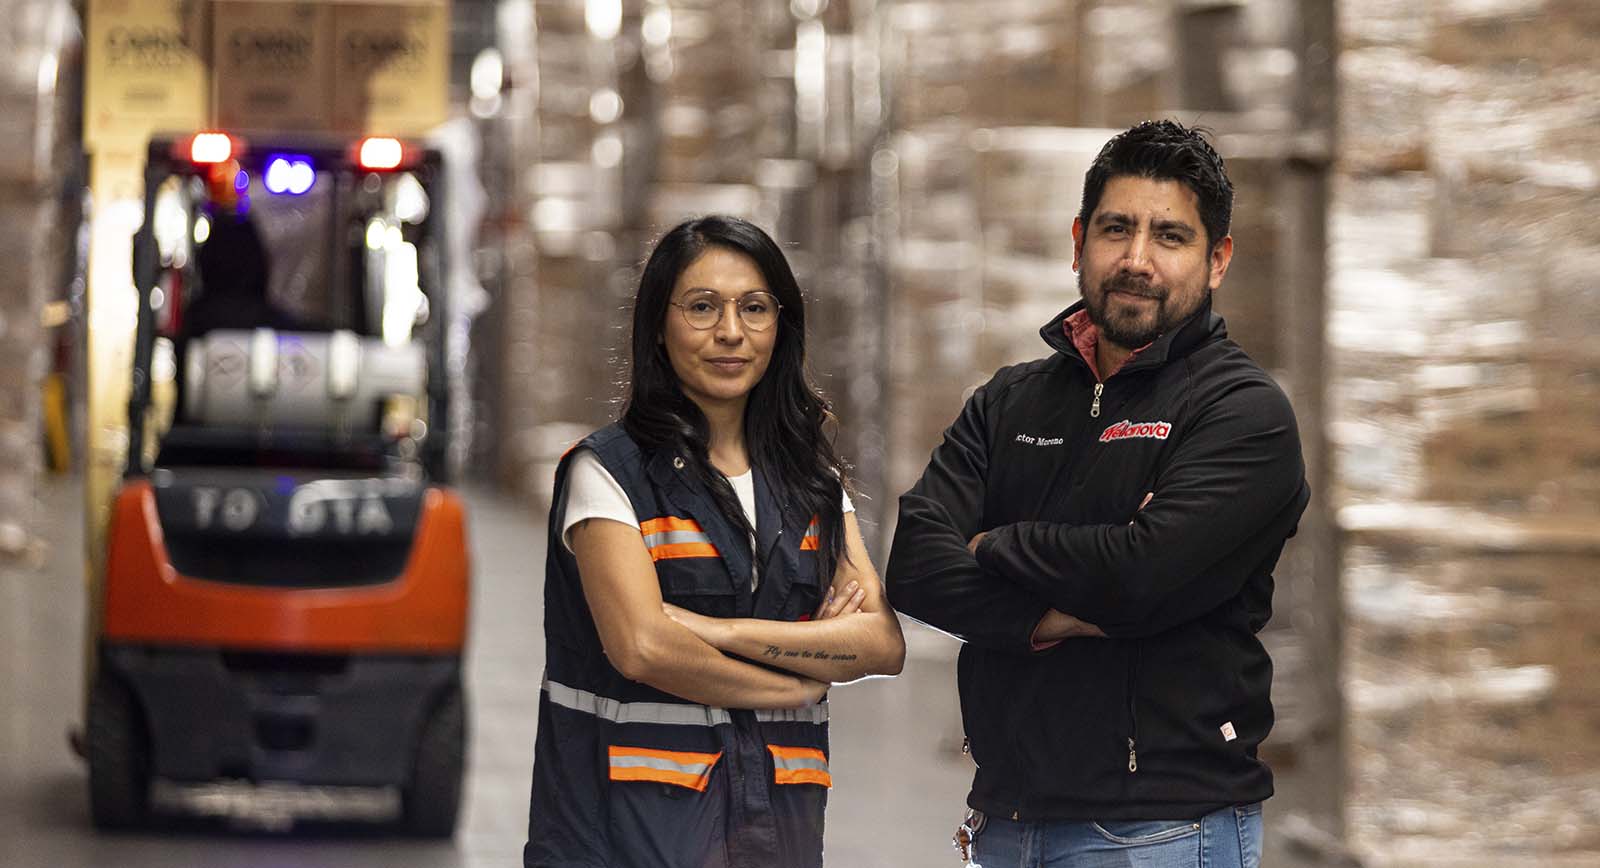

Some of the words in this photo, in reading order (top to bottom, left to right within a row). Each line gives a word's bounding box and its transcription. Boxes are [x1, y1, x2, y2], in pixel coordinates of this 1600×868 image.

[1036, 437, 1064, 446] Moreno
[193, 487, 394, 536] TOOTA
[763, 645, 781, 658] Fly
[784, 649, 799, 657] me
[801, 650, 812, 658] to
[814, 650, 829, 660] the
